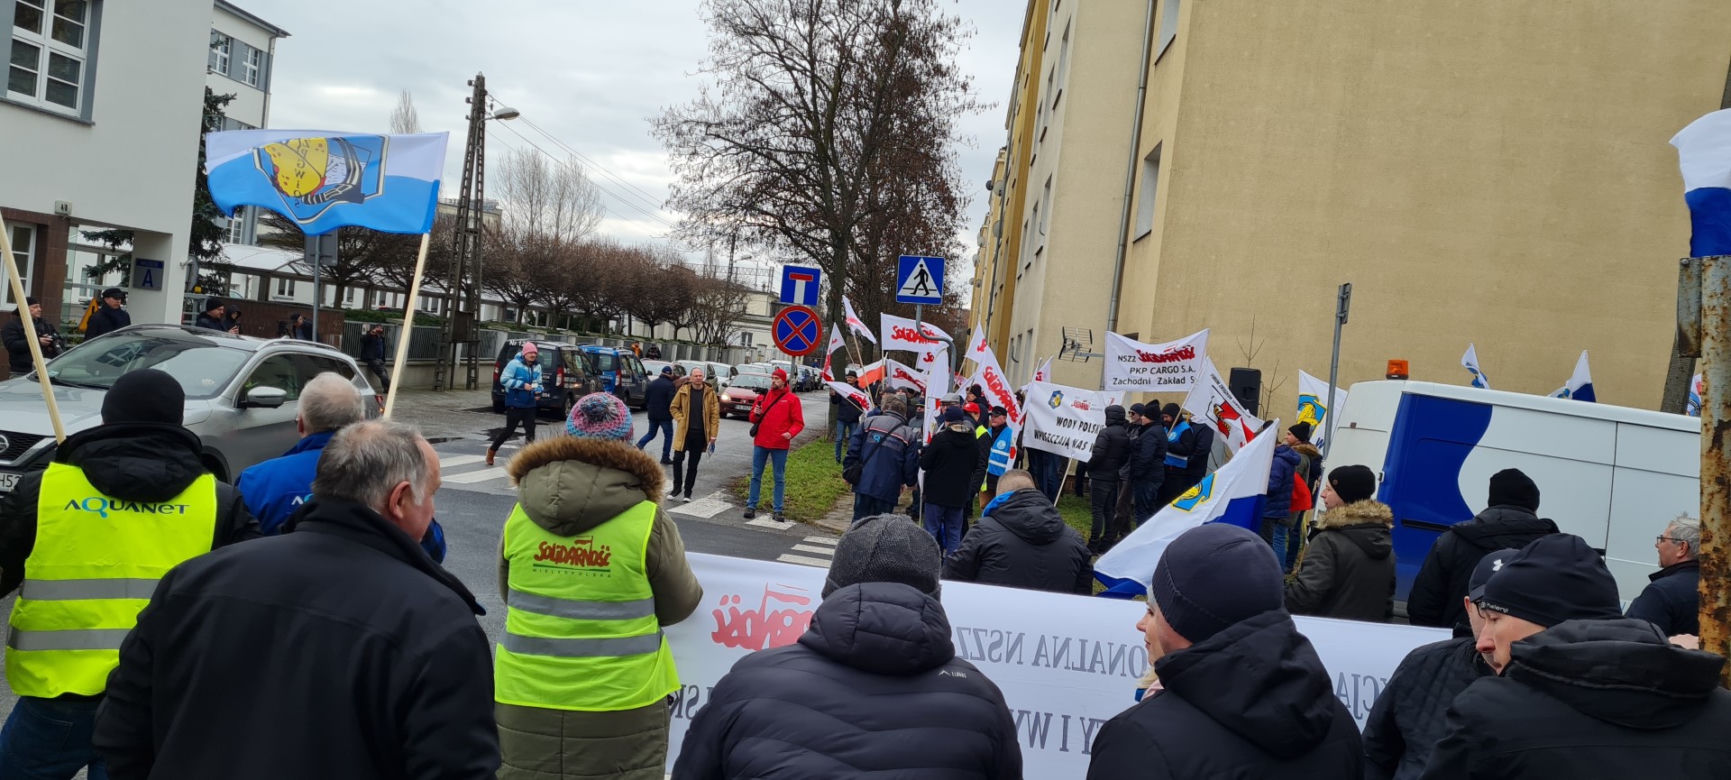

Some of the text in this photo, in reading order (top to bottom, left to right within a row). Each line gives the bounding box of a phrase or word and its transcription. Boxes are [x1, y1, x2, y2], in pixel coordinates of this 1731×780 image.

[142, 269, 154, 288] A
[1117, 355, 1137, 363] NSZZ
[1129, 364, 1197, 375] PKP CARGO S.A.
[1112, 377, 1152, 386] Zachodni
[1156, 376, 1186, 385] Zakład
[1056, 416, 1078, 430] WODY
